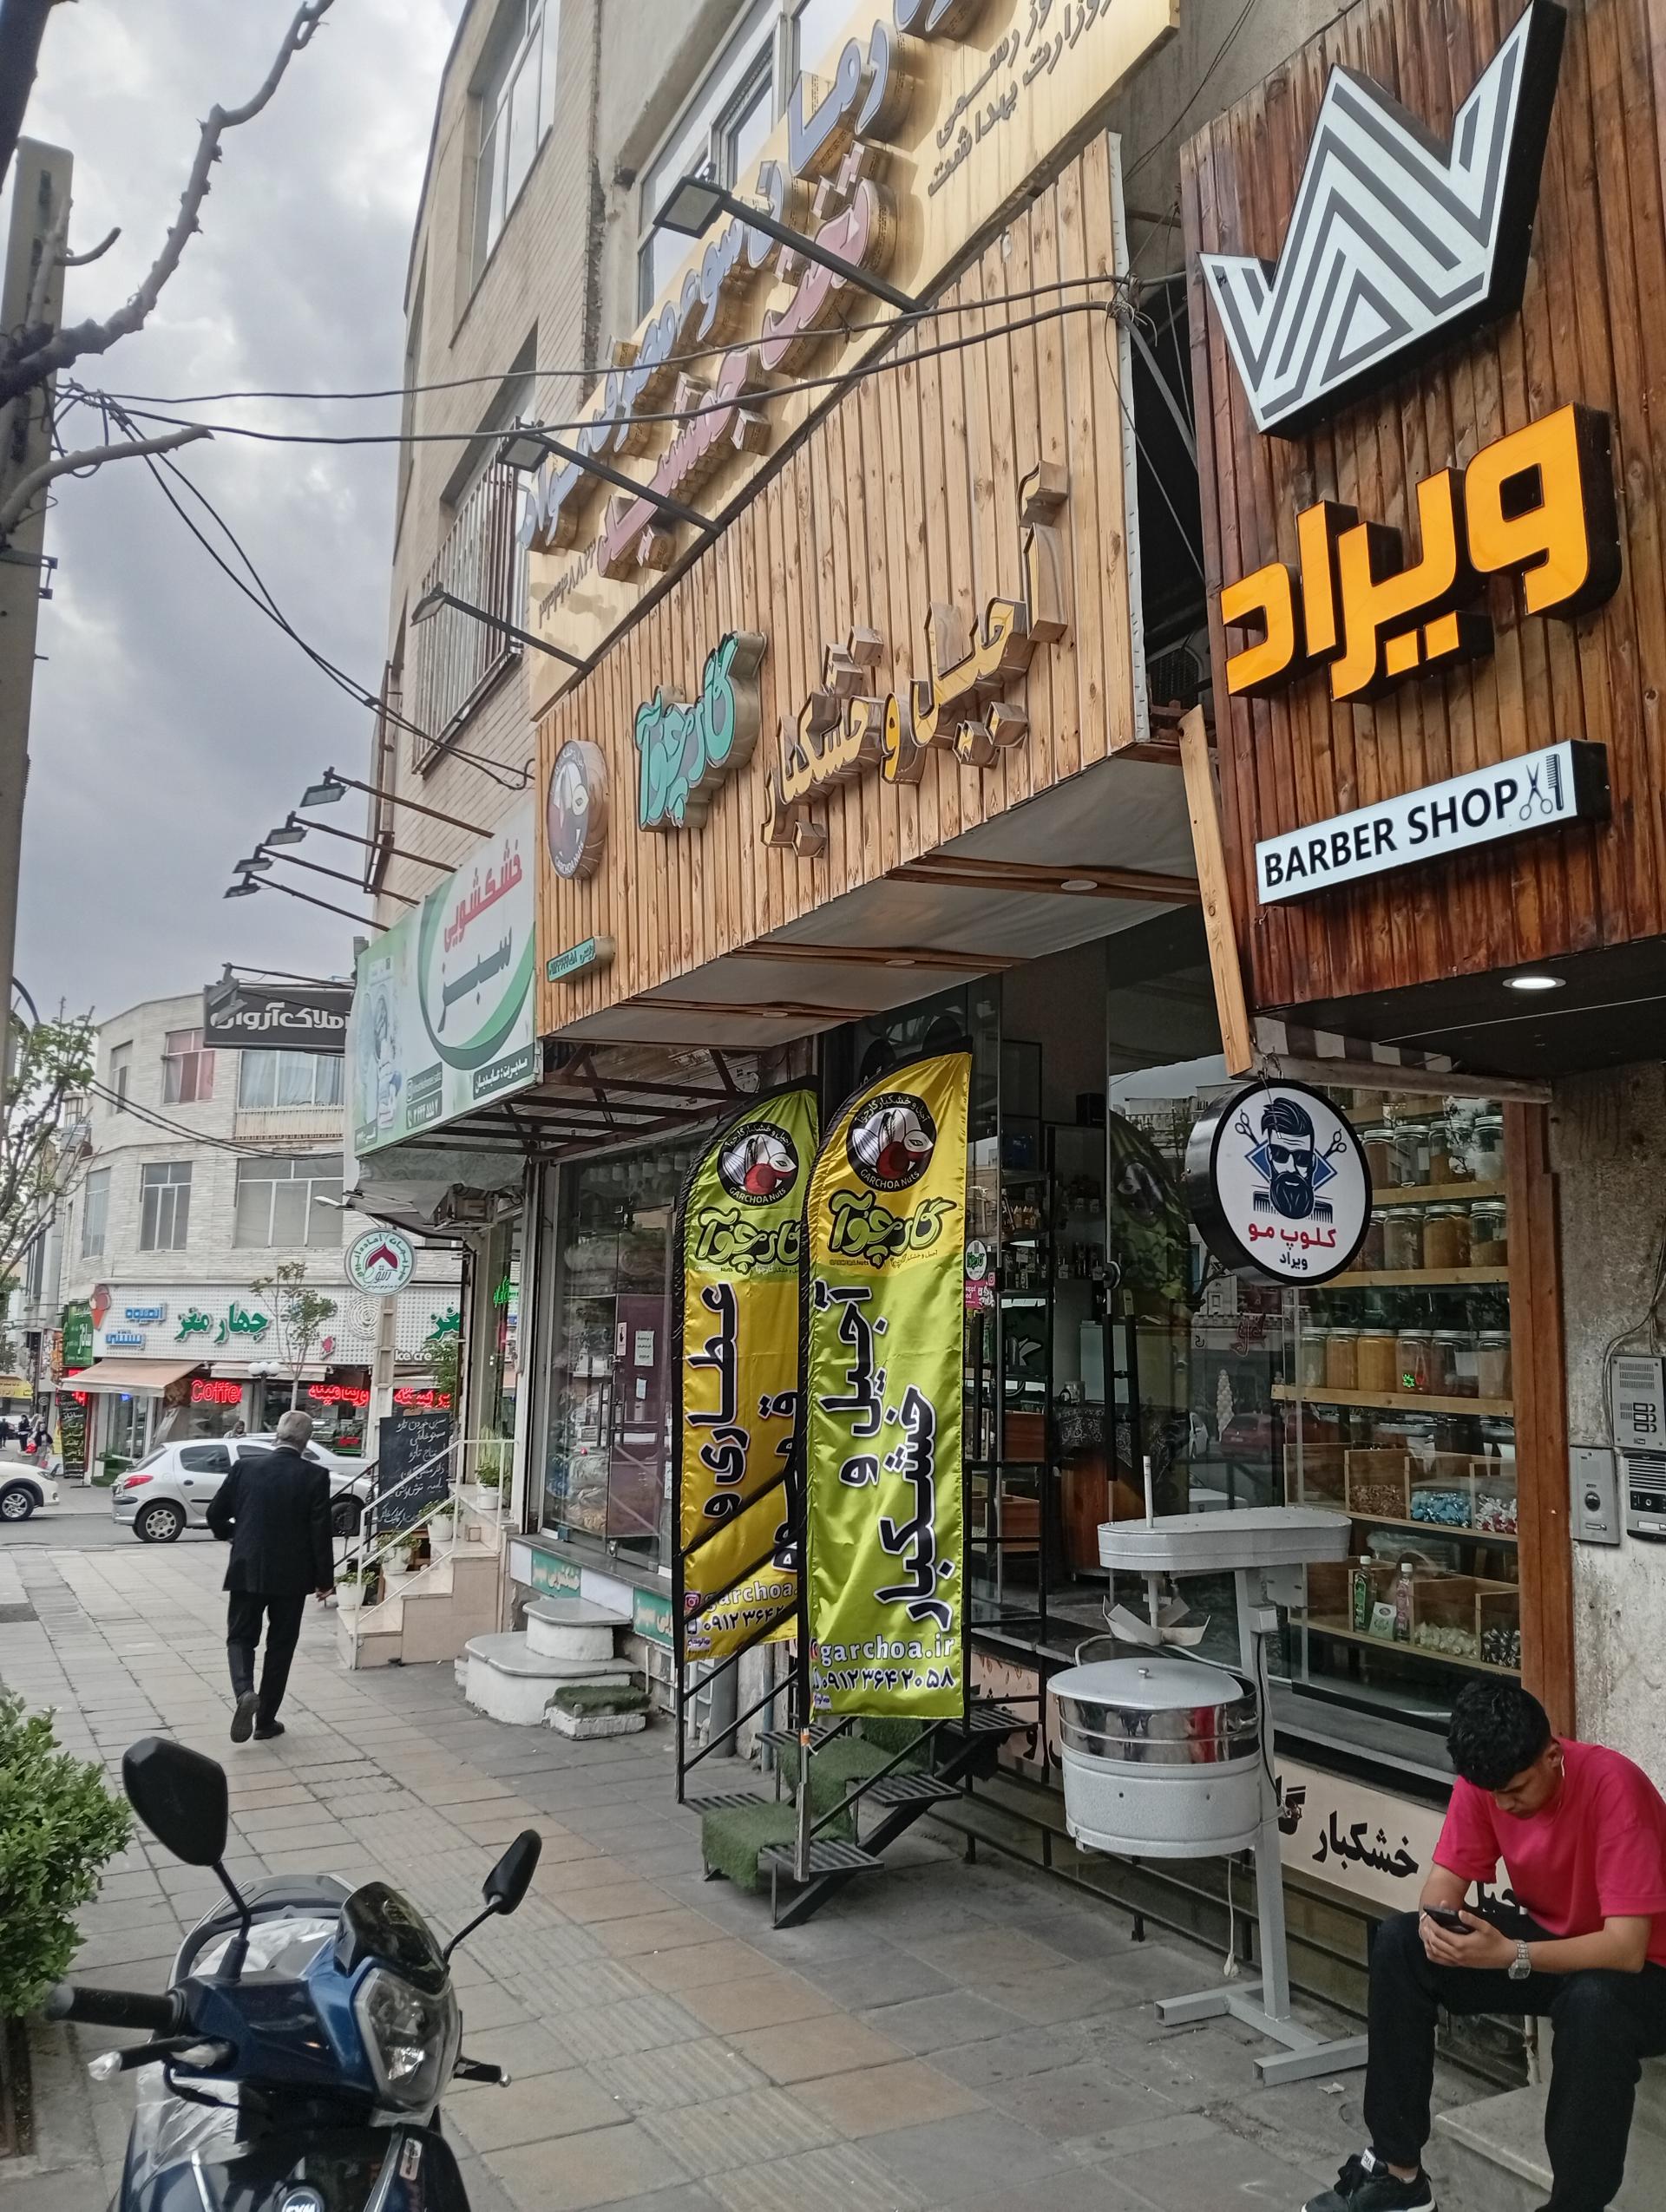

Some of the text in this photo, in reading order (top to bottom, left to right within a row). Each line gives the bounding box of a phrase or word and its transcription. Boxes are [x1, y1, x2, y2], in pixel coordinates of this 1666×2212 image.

[937, 29, 1020, 149] رسمی
[928, 81, 1018, 198] بهداشت
[1220, 400, 1590, 702] ویراد
[1264, 778, 1518, 887] BARBER SHOP
[444, 839, 522, 952] خشکشویی
[437, 926, 512, 1033] سبز
[279, 1007, 351, 1030] ملاک
[729, 1186, 787, 1204] GARCHOA Nuts
[860, 1168, 920, 1189] GARCHOA Nuts
[1248, 1223, 1337, 1250] کلوپ مو
[1279, 1252, 1309, 1271] ویراد
[174, 1302, 270, 1345] چهار مغز
[426, 1306, 460, 1343] غز
[395, 1350, 411, 1361] Ice
[687, 1282, 751, 1486] عطاری
[814, 1278, 889, 1489] آجیل و
[703, 1491, 744, 1520] و
[874, 1384, 956, 1633] خشکبار
[705, 1580, 798, 1613] archoa.
[704, 1604, 785, 1632] ۰۹۱۲۳۶۴۲
[820, 1632, 955, 1668] garchoa.ir
[1312, 1810, 1420, 1878] خشکبار
